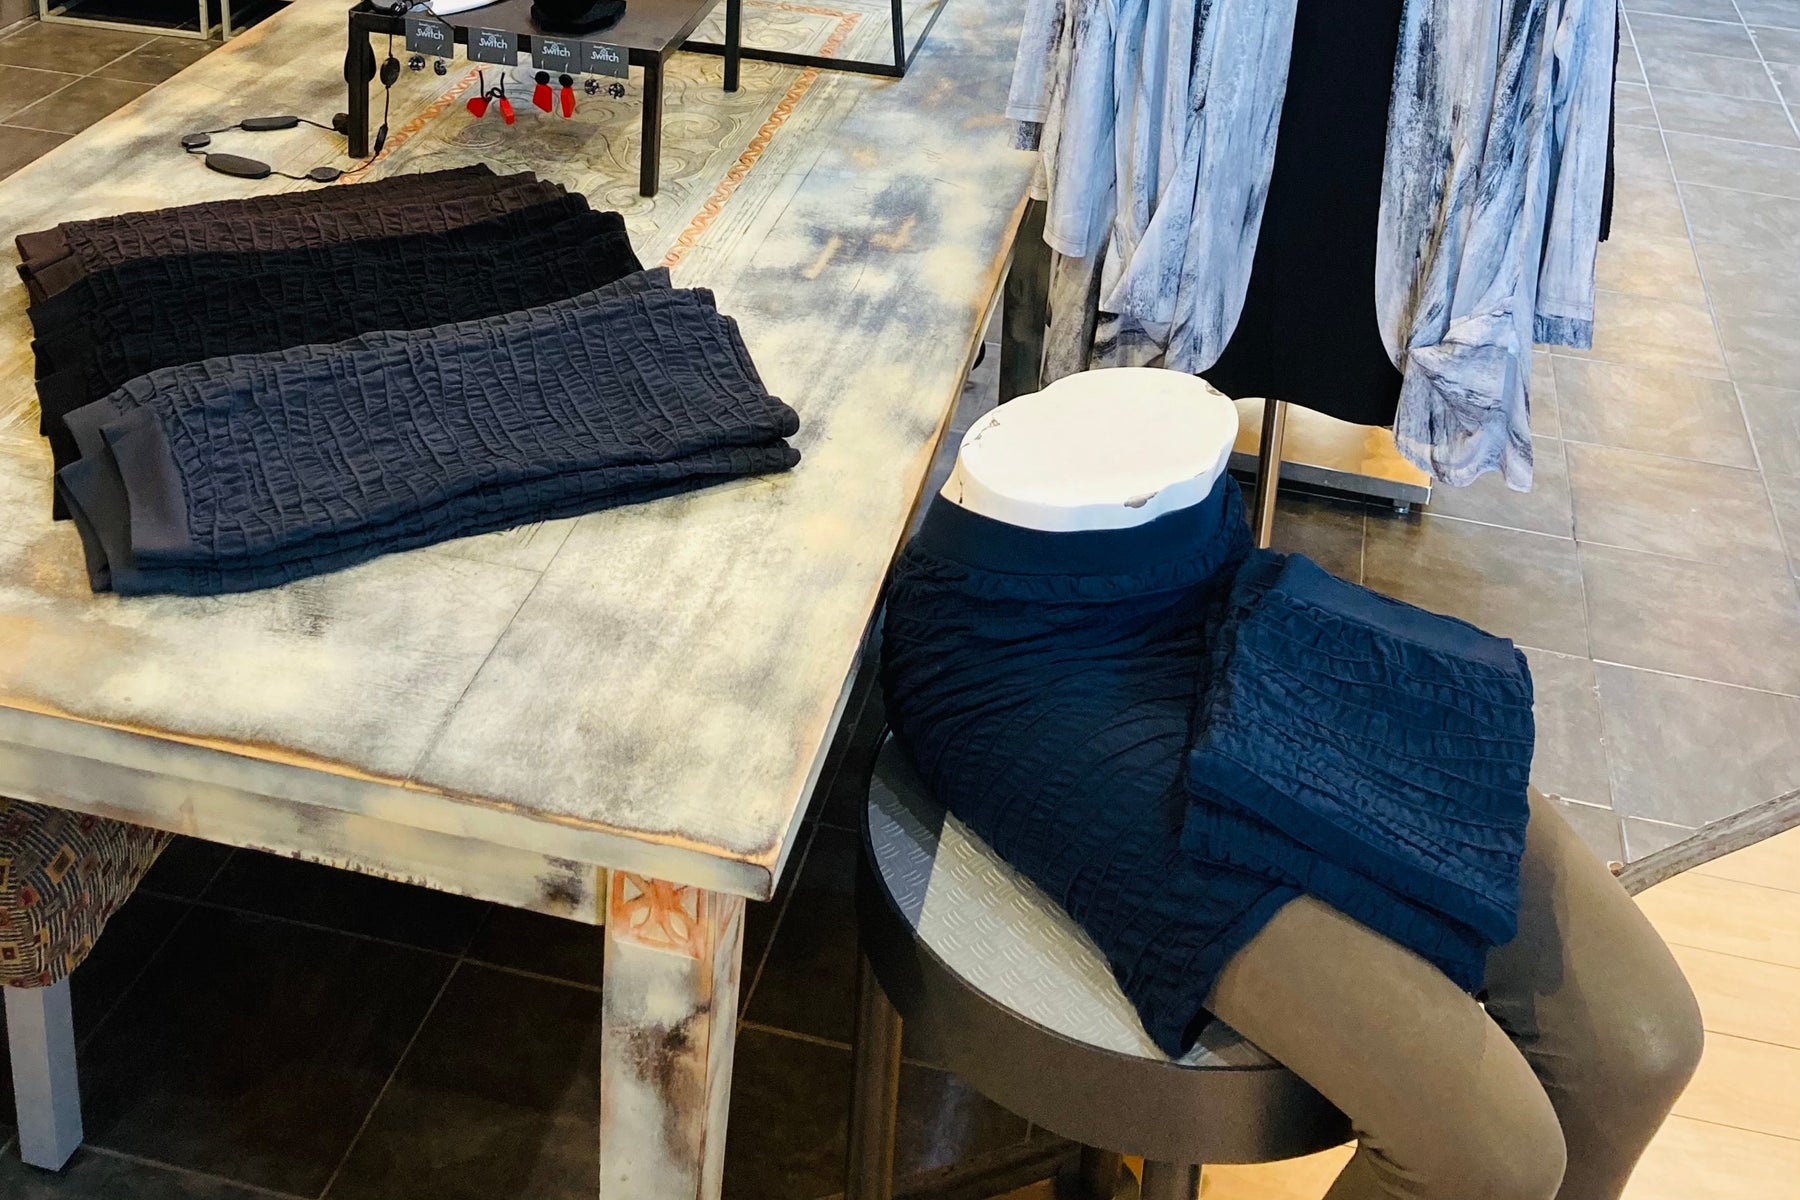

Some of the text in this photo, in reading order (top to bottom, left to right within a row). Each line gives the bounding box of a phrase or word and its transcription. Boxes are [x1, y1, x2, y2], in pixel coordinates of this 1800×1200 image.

[416, 27, 444, 41] Switch
[479, 37, 508, 49] Switch
[541, 45, 571, 57] Switch
[590, 50, 619, 63] Switch
